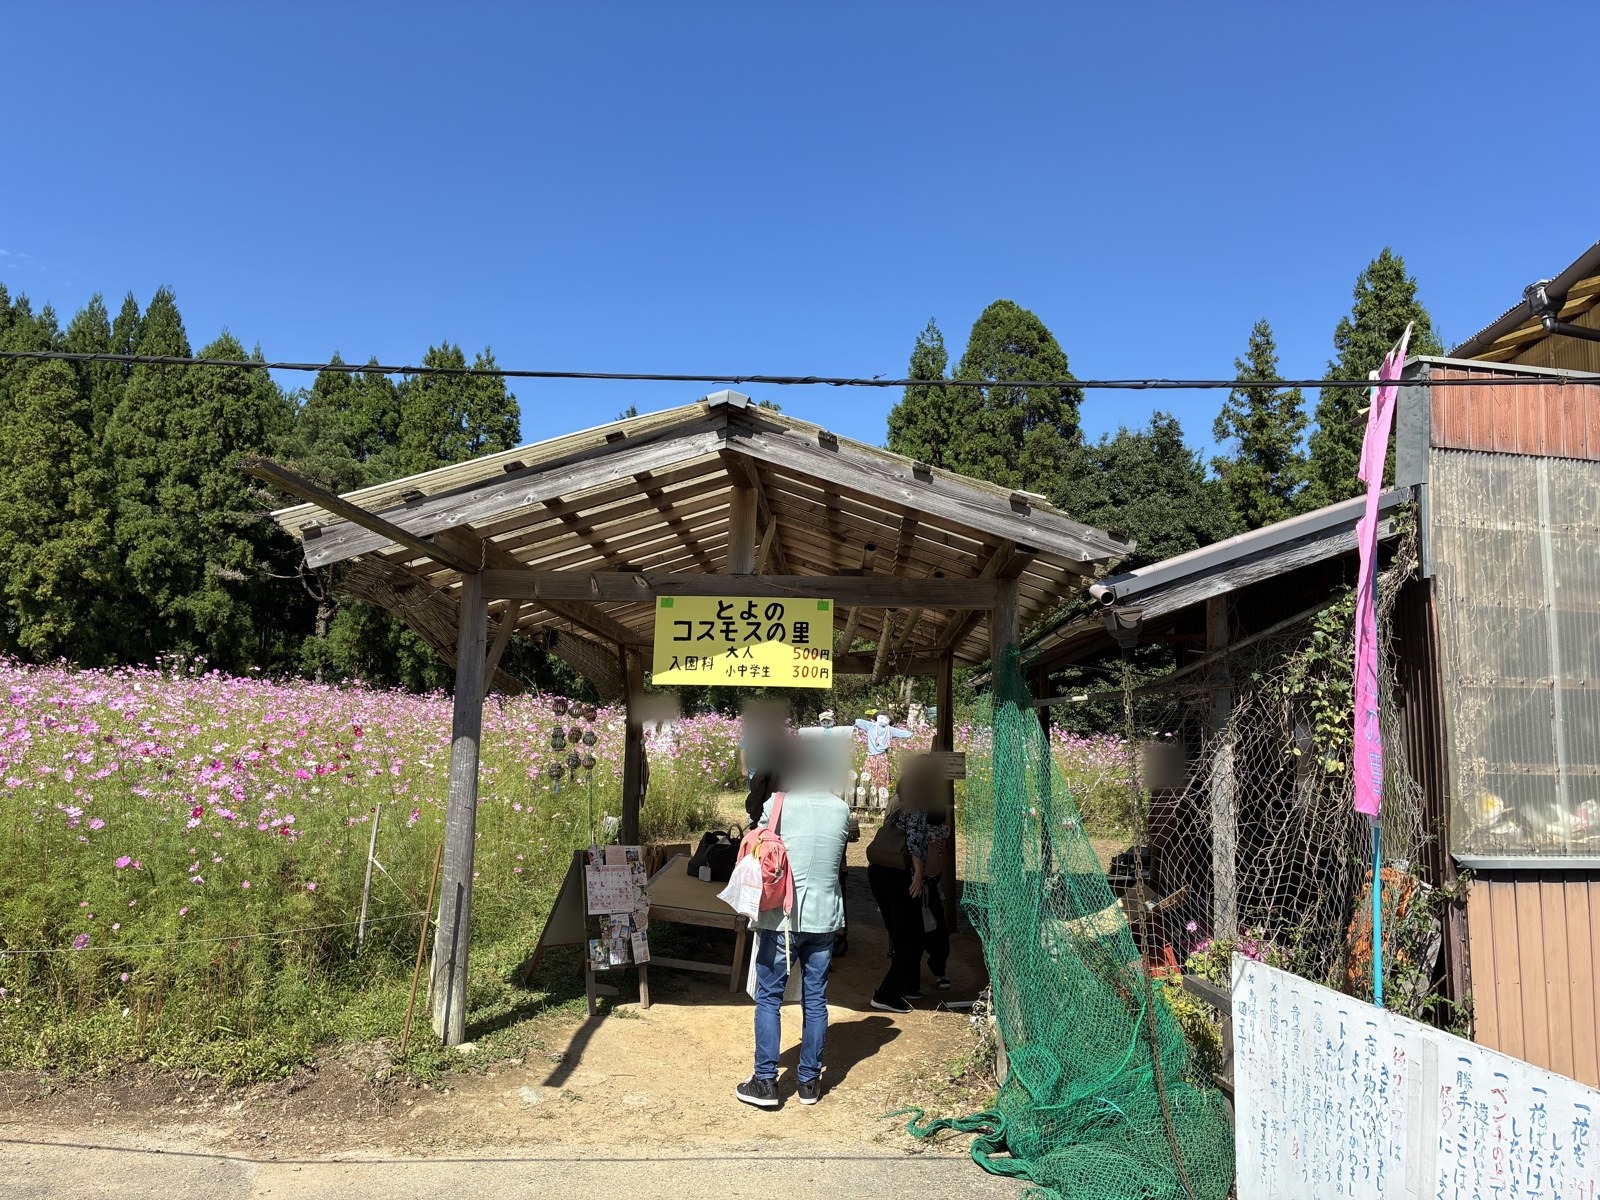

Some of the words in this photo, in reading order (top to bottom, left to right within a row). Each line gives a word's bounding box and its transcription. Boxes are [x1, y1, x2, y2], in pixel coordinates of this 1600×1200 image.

[716, 600, 784, 621] とよの
[673, 620, 810, 644] コスモスの里
[725, 646, 754, 659] 大人
[793, 647, 830, 661] 500円
[669, 656, 714, 671] 入園料
[725, 664, 771, 678] 小中学生
[792, 666, 829, 679] 300円
